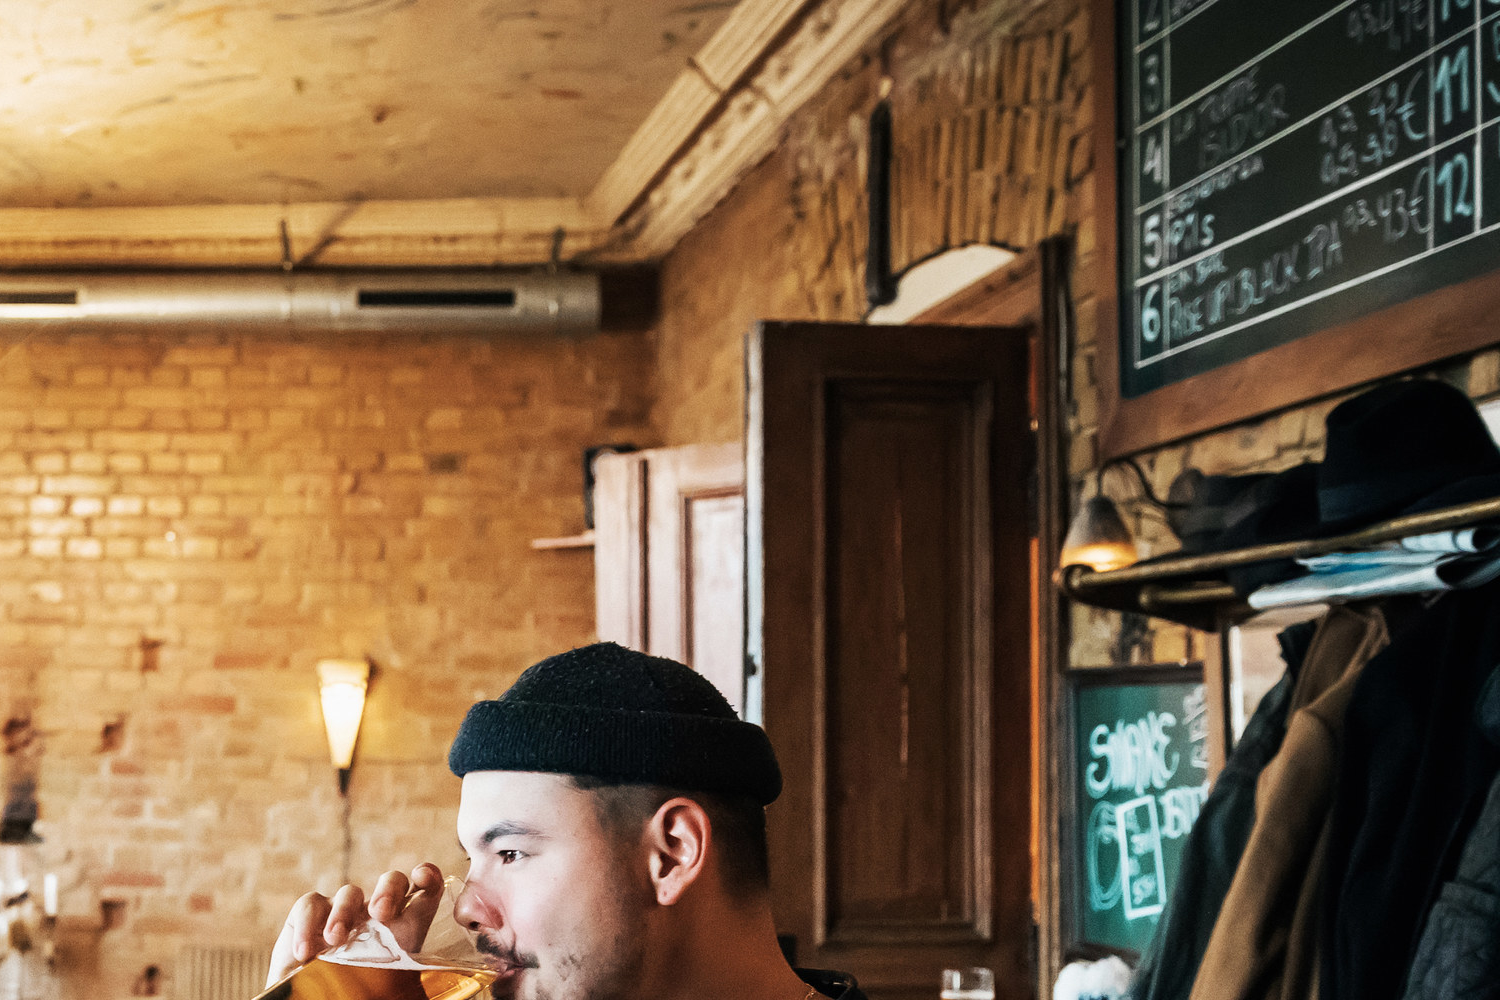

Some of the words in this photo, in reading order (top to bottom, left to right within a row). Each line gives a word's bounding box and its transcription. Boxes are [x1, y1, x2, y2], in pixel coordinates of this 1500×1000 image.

[1435, 45, 1470, 124] 11
[1143, 135, 1163, 183] 4
[1437, 152, 1474, 223] 12
[1143, 213, 1162, 268] 5
[1142, 284, 1161, 342] 6
